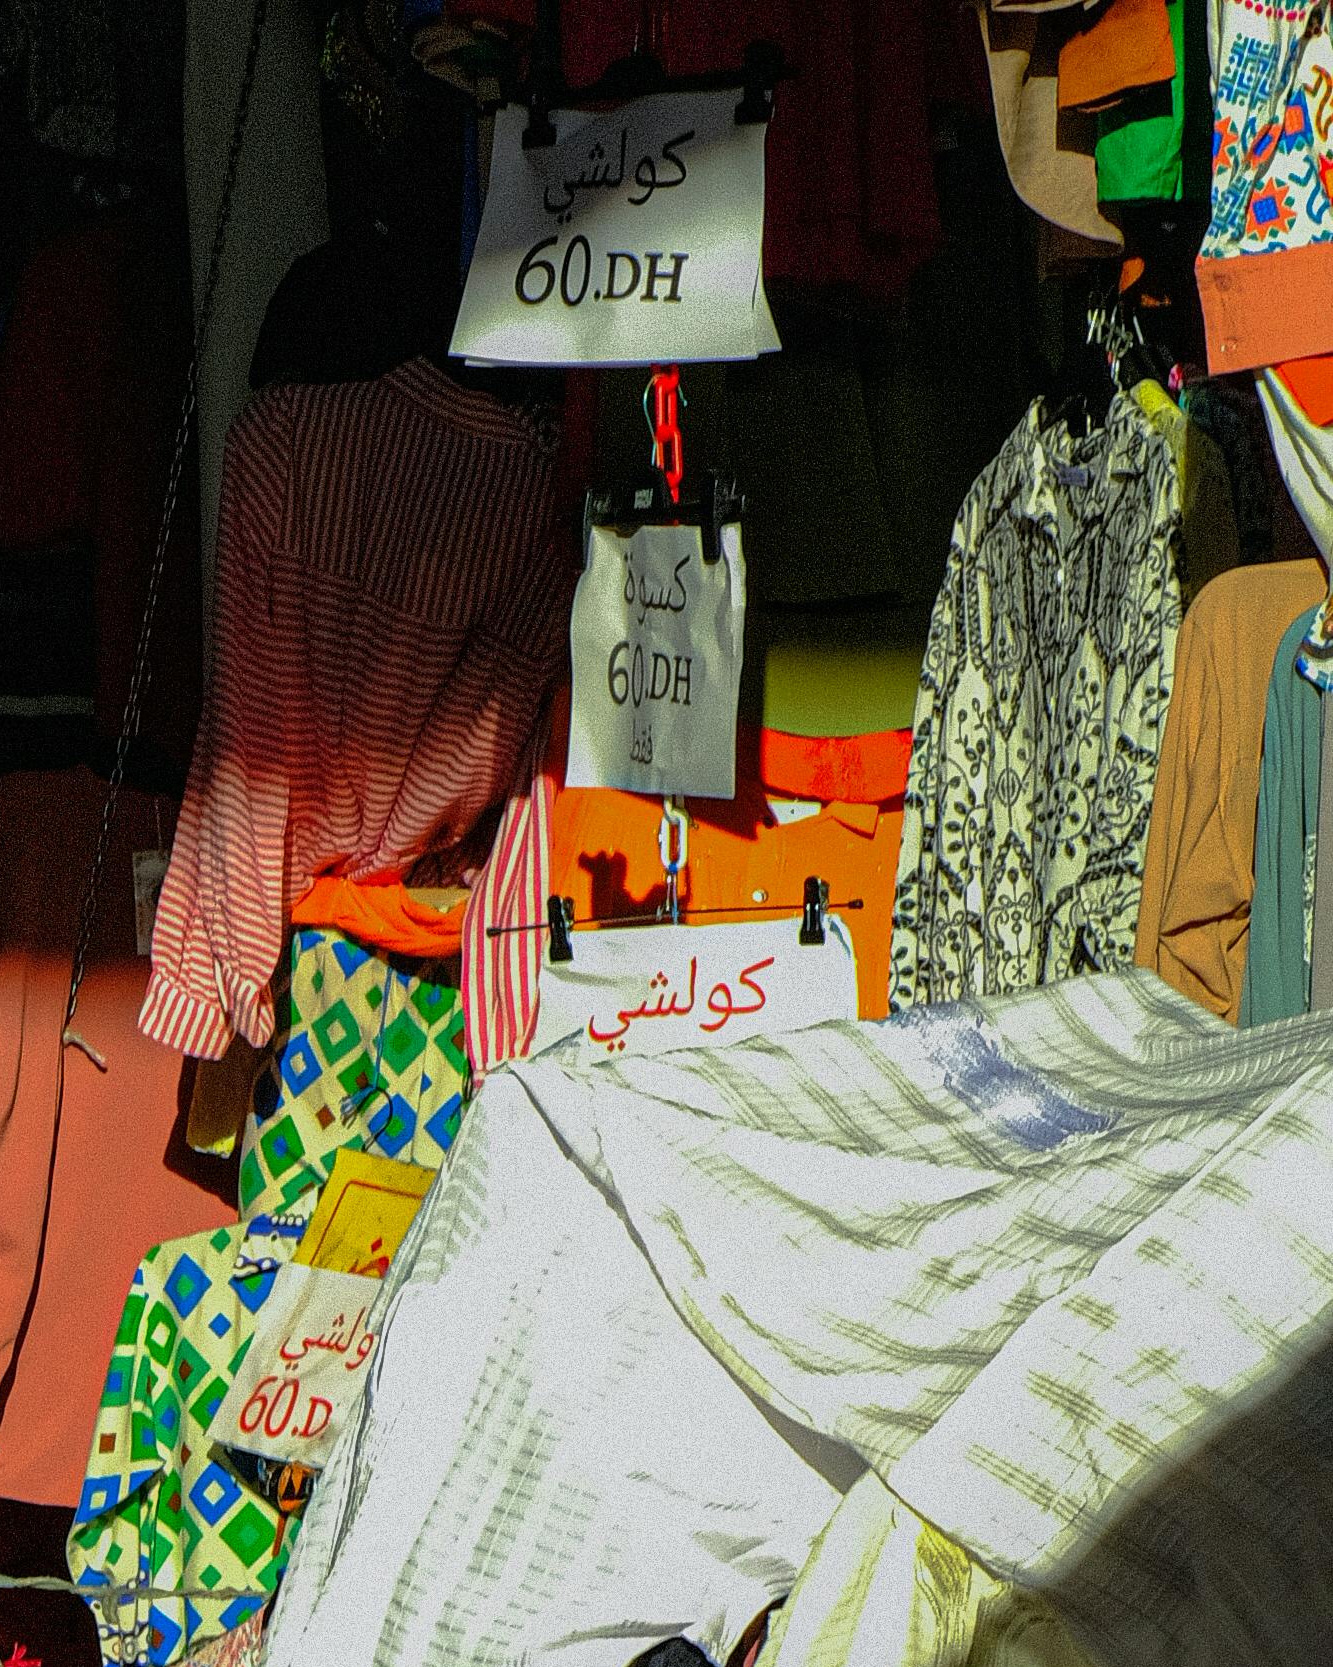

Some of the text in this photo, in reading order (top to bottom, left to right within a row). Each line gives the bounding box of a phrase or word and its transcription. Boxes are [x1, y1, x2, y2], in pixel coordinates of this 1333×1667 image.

[543, 128, 696, 224] كولشي
[514, 234, 690, 307] 60.DH
[607, 640, 693, 708] 60.DH
[587, 955, 775, 1053] كولشي
[279, 1306, 375, 1372] ولشي
[239, 1375, 334, 1439] 60.D
